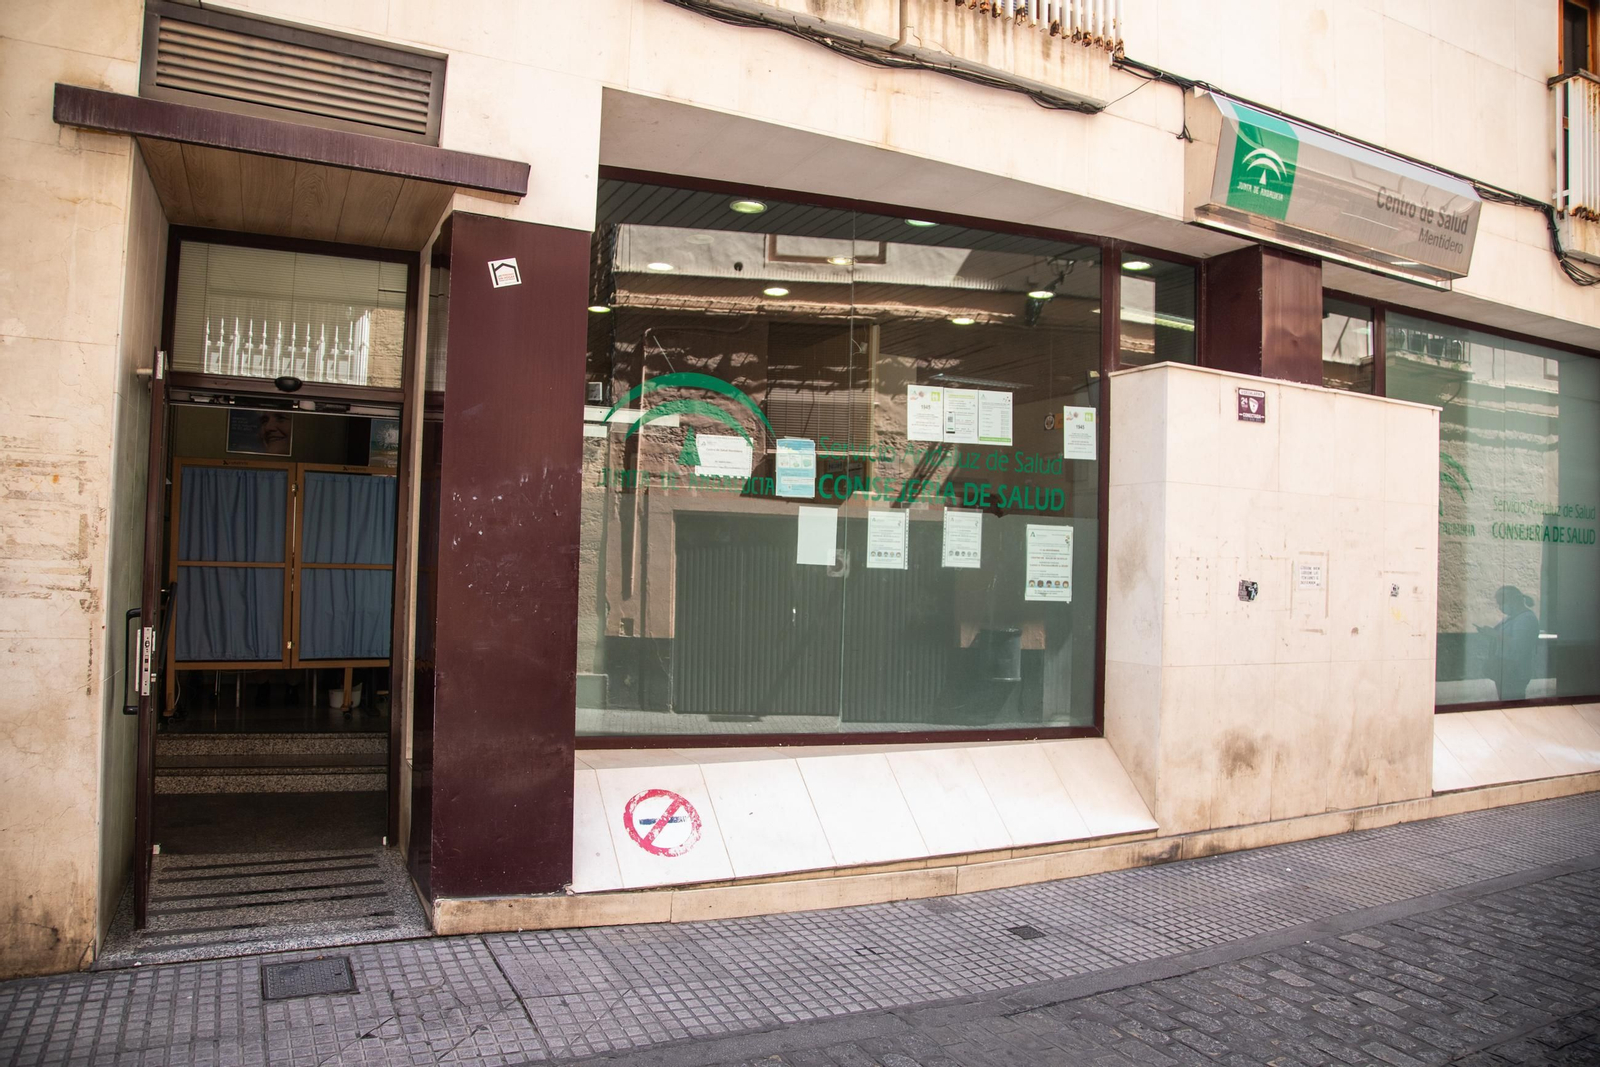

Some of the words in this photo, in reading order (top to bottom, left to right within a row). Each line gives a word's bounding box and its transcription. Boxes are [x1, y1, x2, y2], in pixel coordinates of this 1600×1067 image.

[1376, 186, 1416, 219] Centro
[1419, 201, 1434, 224] de
[1437, 206, 1469, 235] Salud
[1418, 228, 1464, 254] Mentidero
[819, 436, 895, 464] Servicio
[902, 442, 980, 471] Andaluz
[985, 450, 1008, 472] de
[1013, 451, 1063, 476] Salud
[597, 467, 650, 490] JUNTA
[660, 471, 680, 491] DE
[963, 481, 996, 507] DE
[997, 483, 1065, 512] SALUD
[1493, 495, 1526, 515] Servicio
[1563, 503, 1573, 519] de
[1575, 504, 1596, 520] Salud
[1553, 525, 1565, 543] DE
[1567, 527, 1596, 545] SALUD
